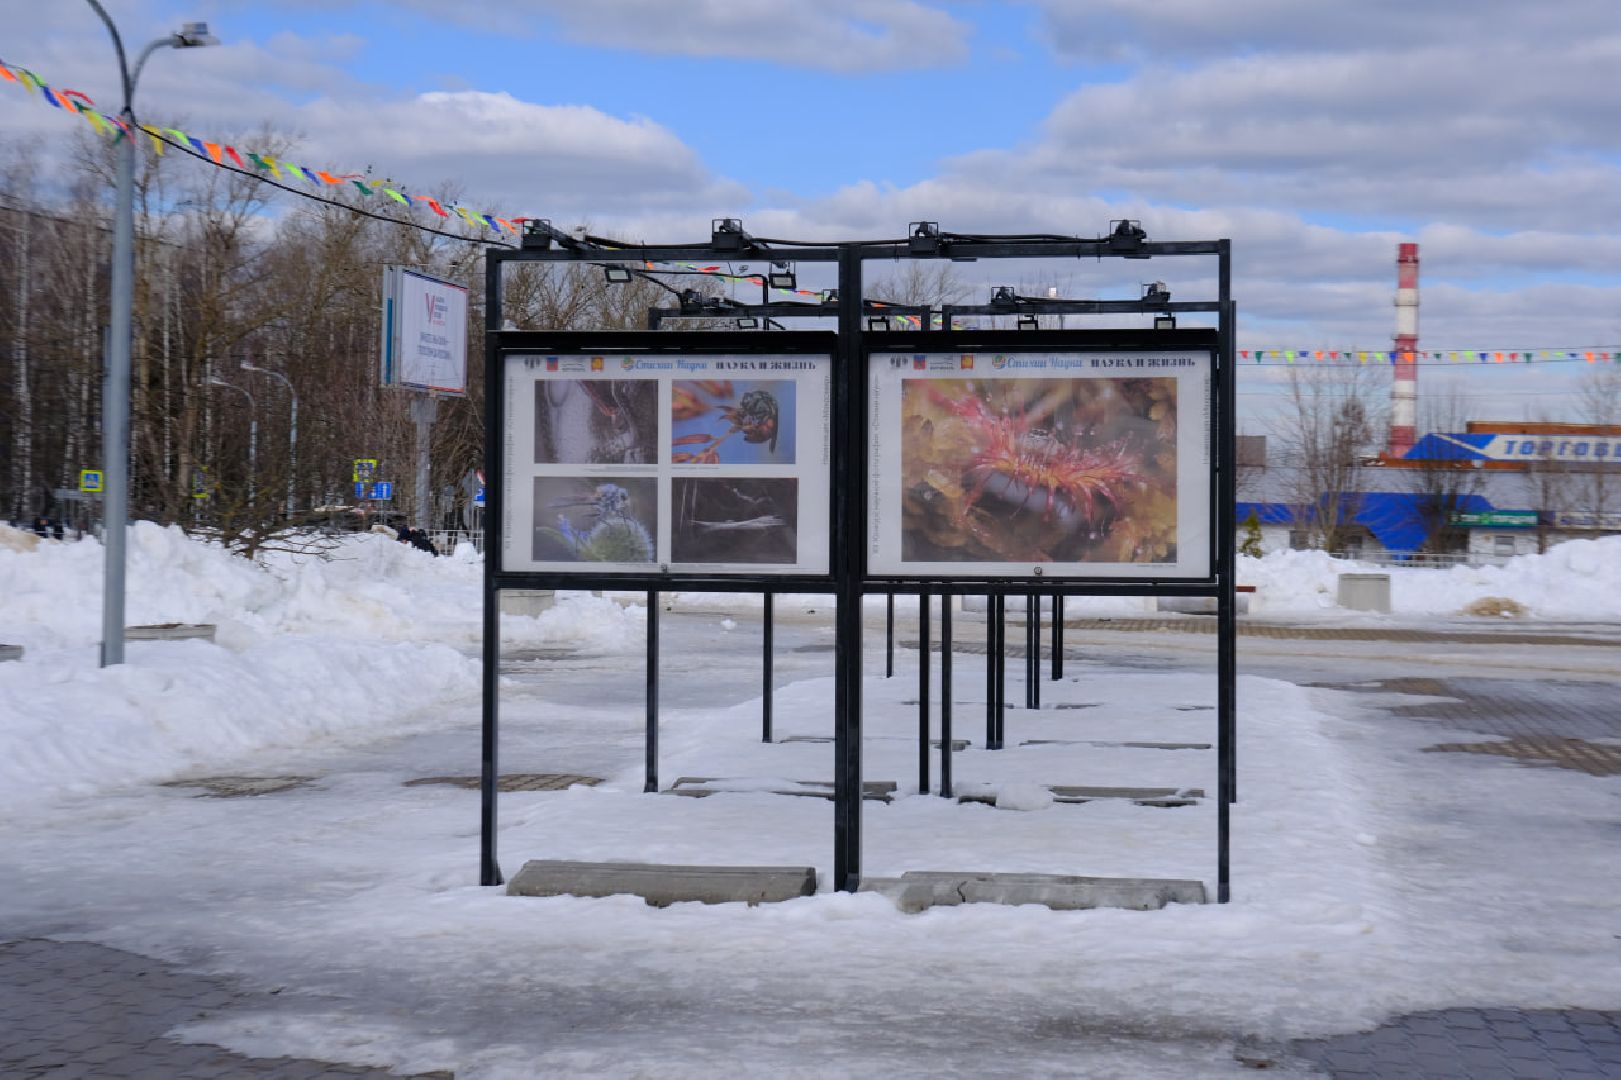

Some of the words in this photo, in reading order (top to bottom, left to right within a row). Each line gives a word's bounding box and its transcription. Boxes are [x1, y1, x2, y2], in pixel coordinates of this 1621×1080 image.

[715, 361, 756, 370] НАУКА
[758, 361, 767, 370] И
[770, 361, 816, 370] ЖИЗНЬ
[1091, 358, 1133, 368] НАУКА
[1136, 358, 1144, 368] И
[1147, 358, 1196, 368] ЖИЗНЬ
